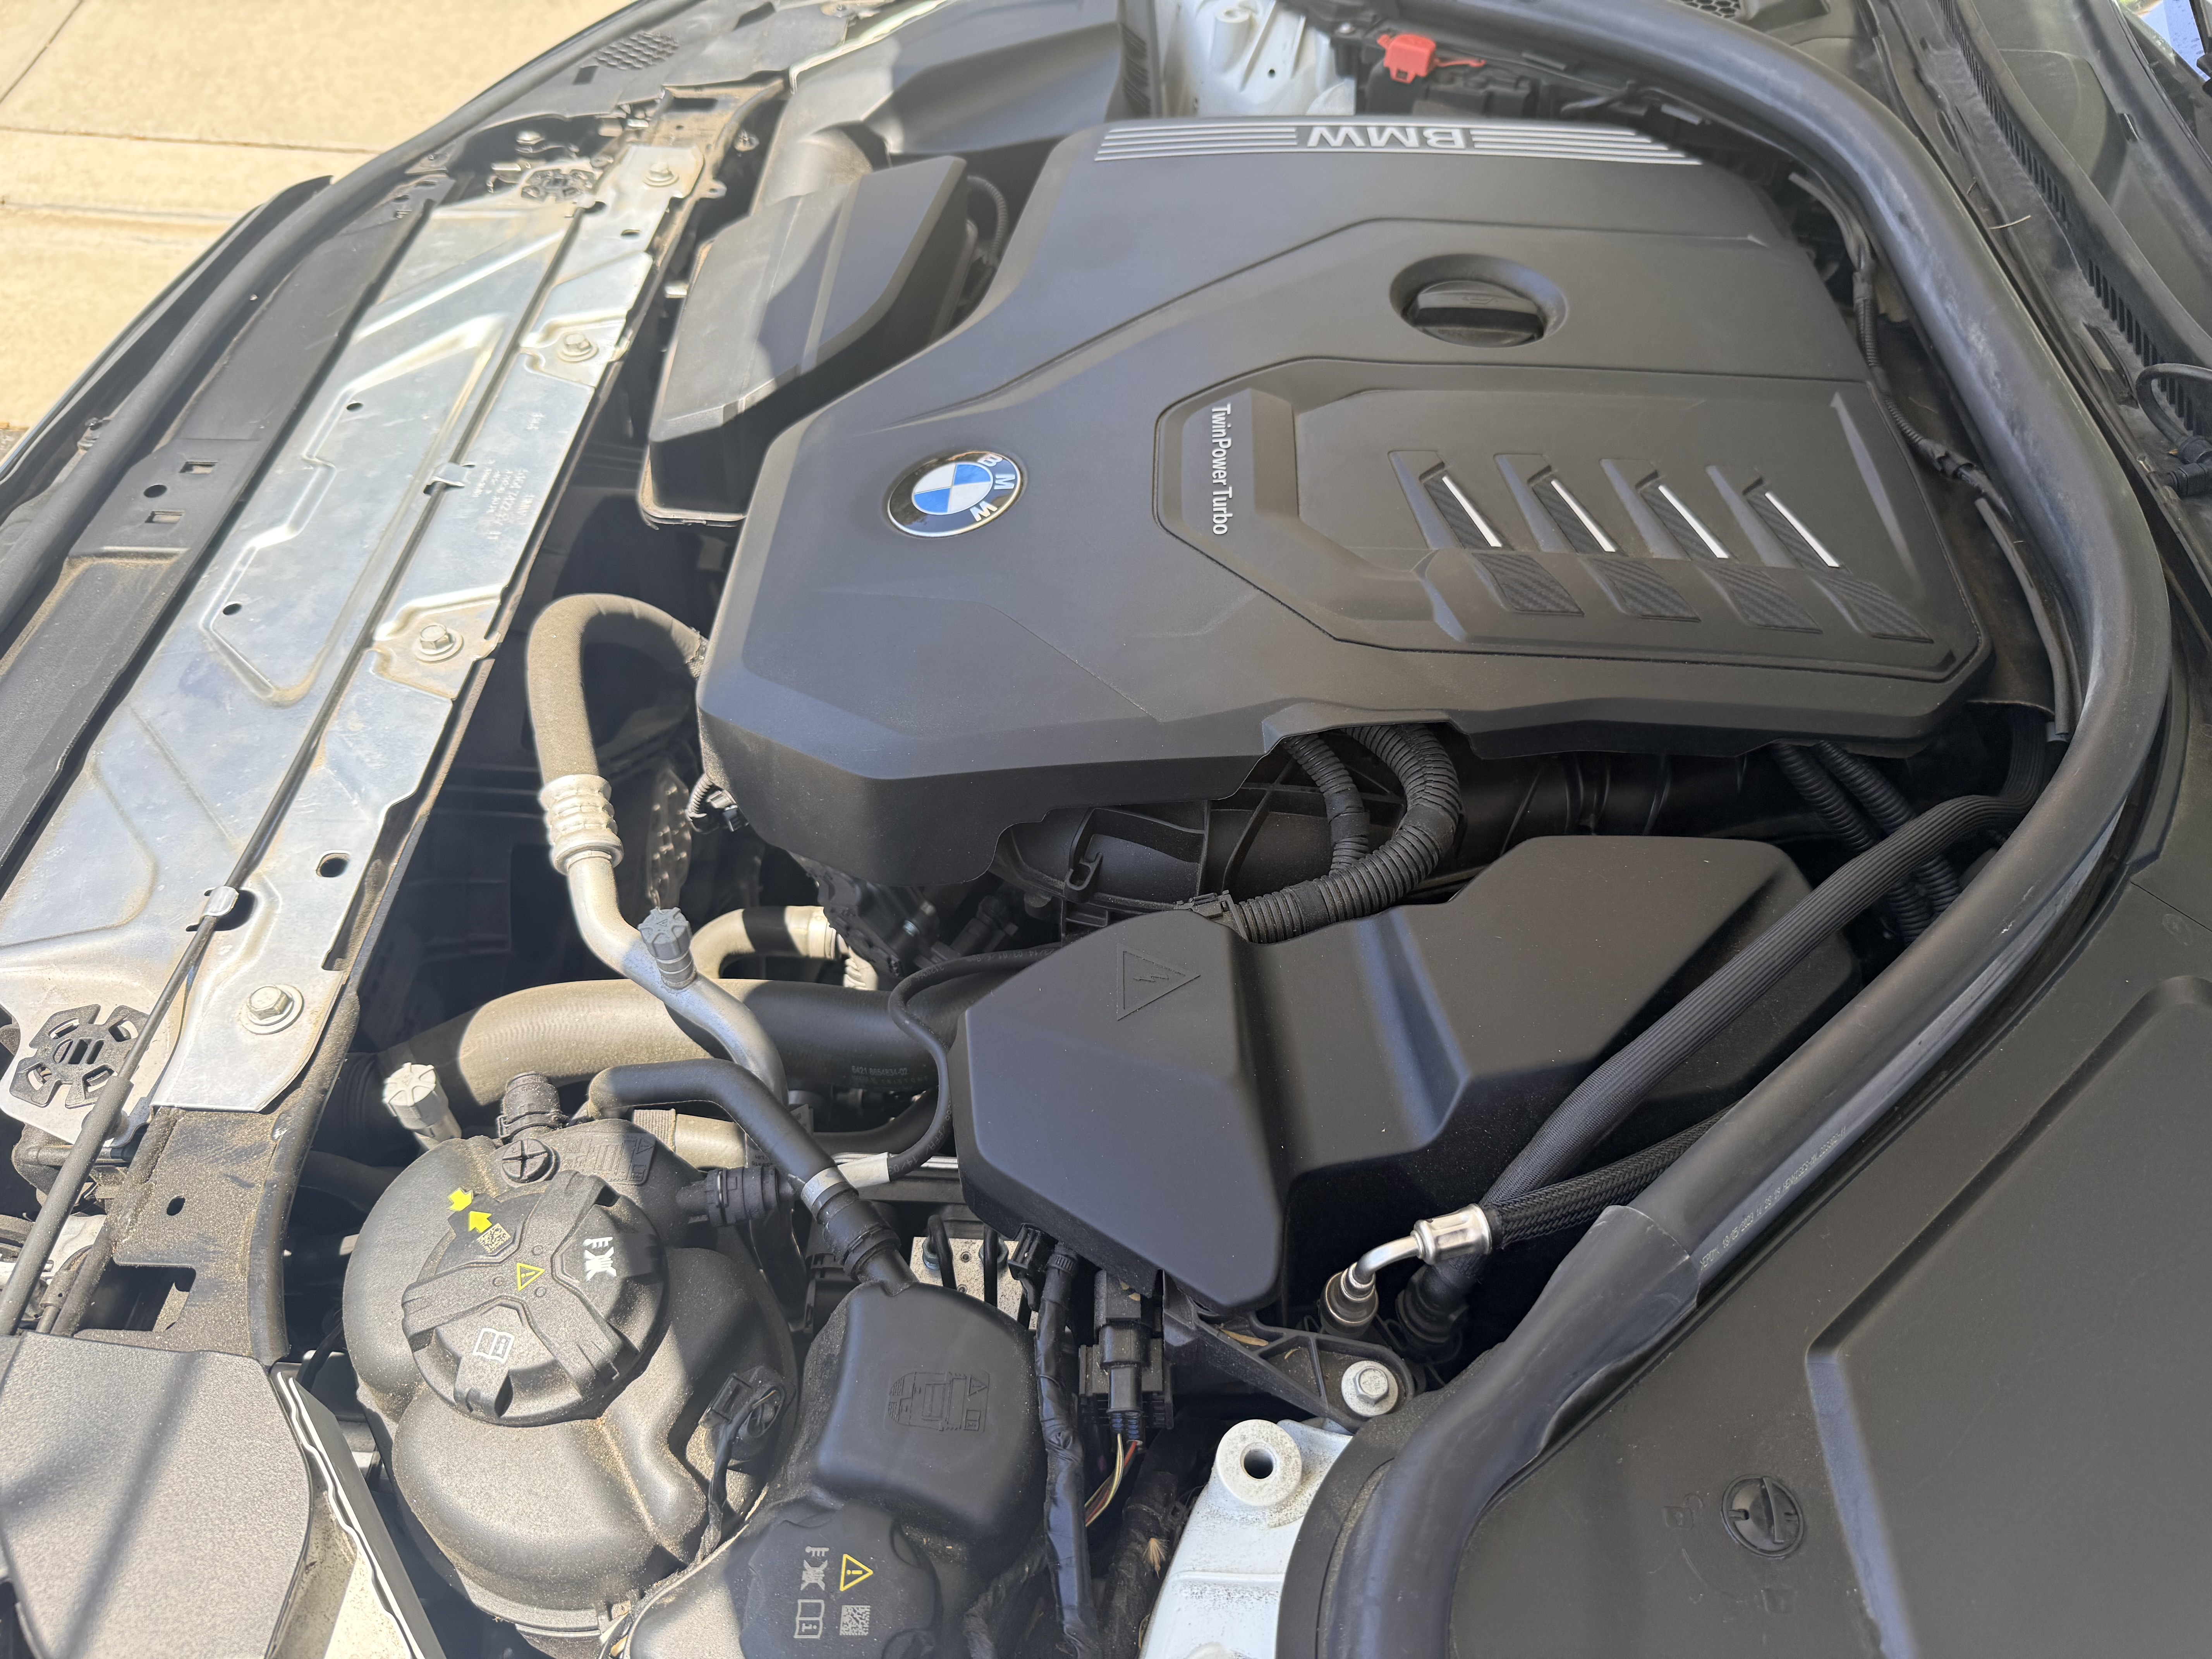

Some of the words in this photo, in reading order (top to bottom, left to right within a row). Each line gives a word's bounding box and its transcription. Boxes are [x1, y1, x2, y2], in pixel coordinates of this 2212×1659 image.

[1307, 126, 1465, 149] BMW
[1211, 402, 1232, 486] TwinPower
[969, 453, 1016, 522] BMW
[1212, 486, 1233, 535] Turbo
[852, 1065, 868, 1075] 6421
